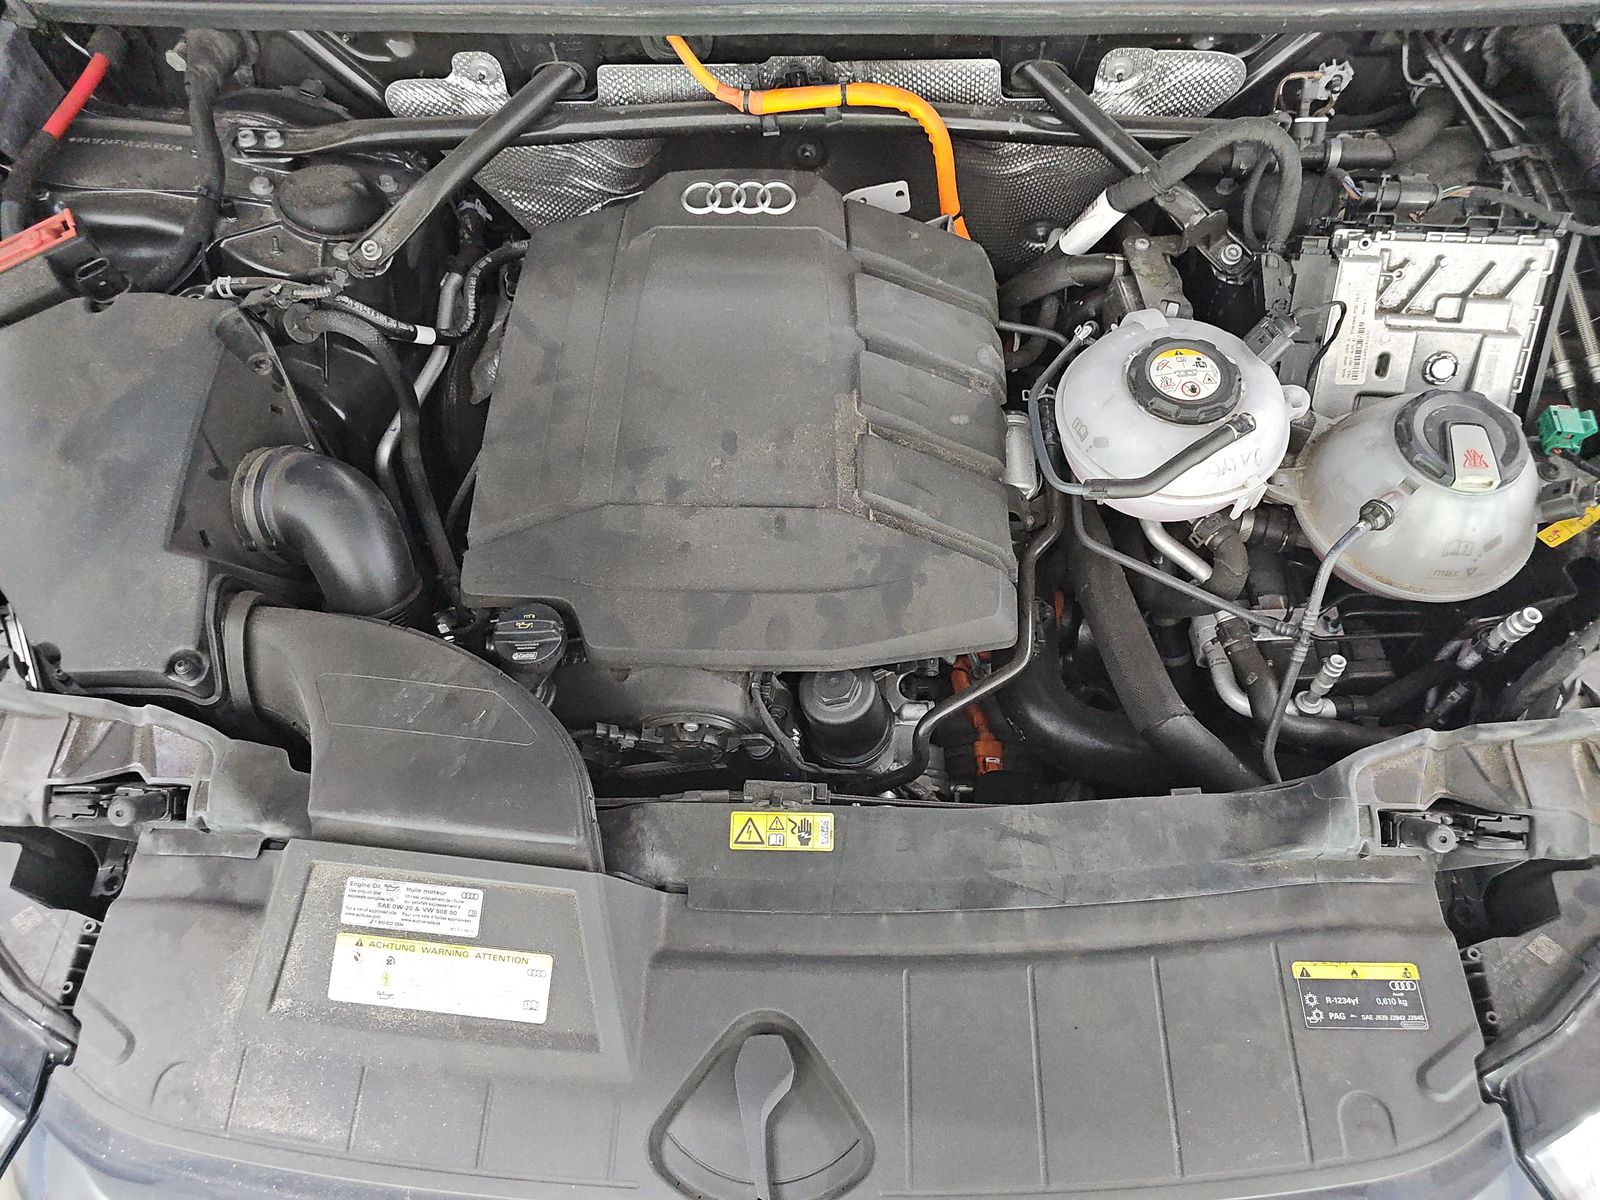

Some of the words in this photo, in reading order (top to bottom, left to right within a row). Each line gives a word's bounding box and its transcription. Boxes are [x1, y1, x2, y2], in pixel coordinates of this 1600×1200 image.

[368, 942, 416, 953] ACHTUNG
[421, 946, 469, 959] WARNING
[475, 952, 530, 965] ATTENTION
[1325, 996, 1360, 1006] R-1234yf
[1376, 997, 1397, 1006] 0,610
[1397, 997, 1409, 1007] kg
[1328, 1012, 1347, 1020] PAG
